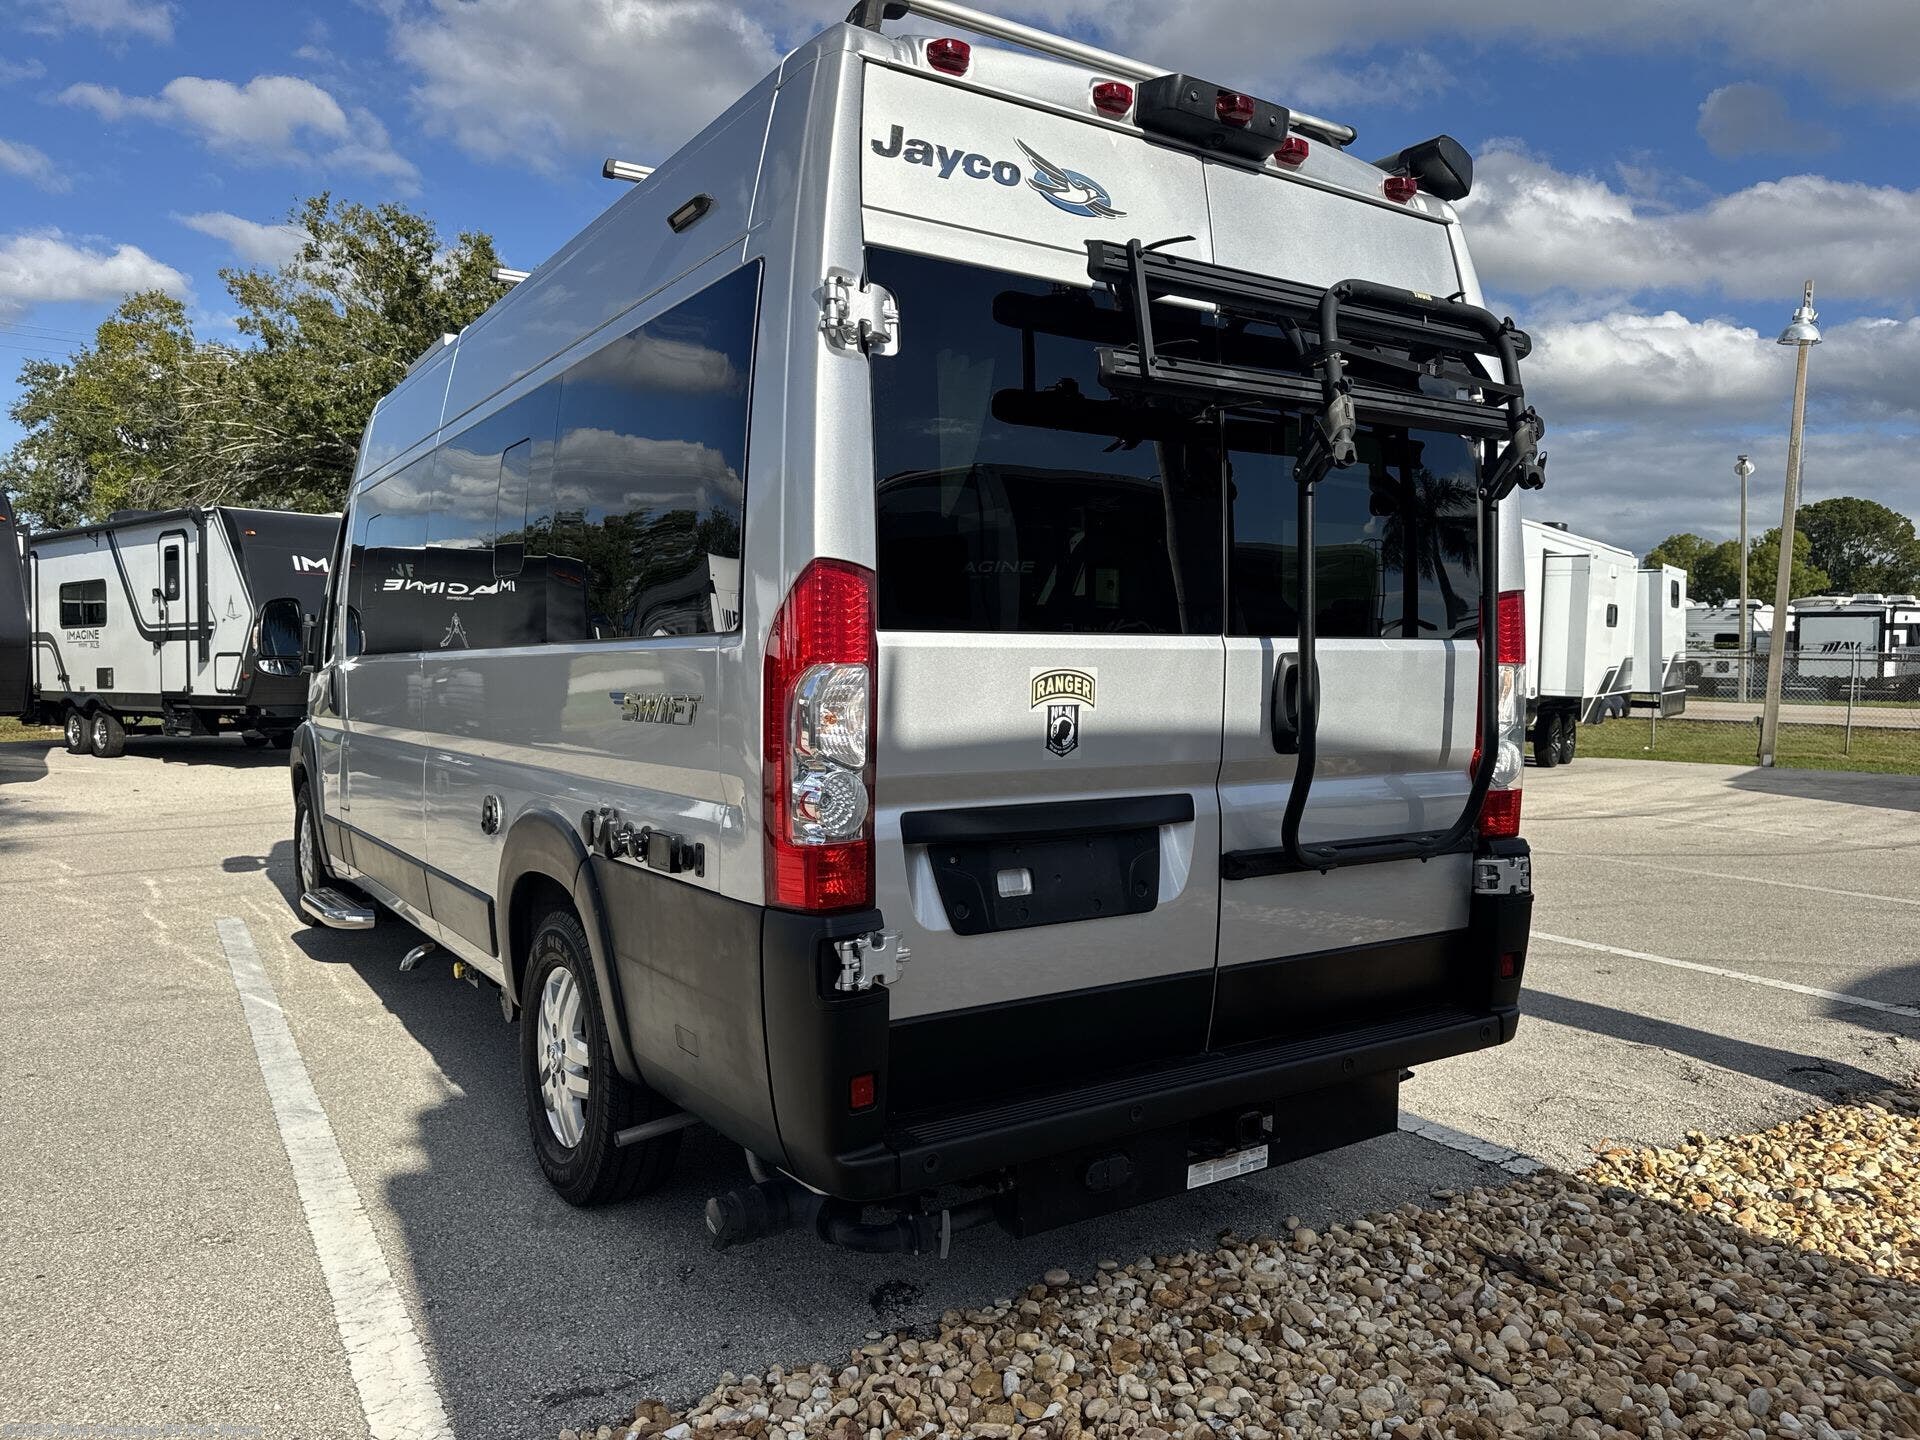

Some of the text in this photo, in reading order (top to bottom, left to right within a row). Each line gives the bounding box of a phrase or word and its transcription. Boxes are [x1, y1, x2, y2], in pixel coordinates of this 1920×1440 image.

[870, 124, 1021, 187] Jayco
[66, 629, 100, 640] IMAGINE
[1036, 674, 1092, 699] RANGER
[620, 692, 704, 727] SWIFT
